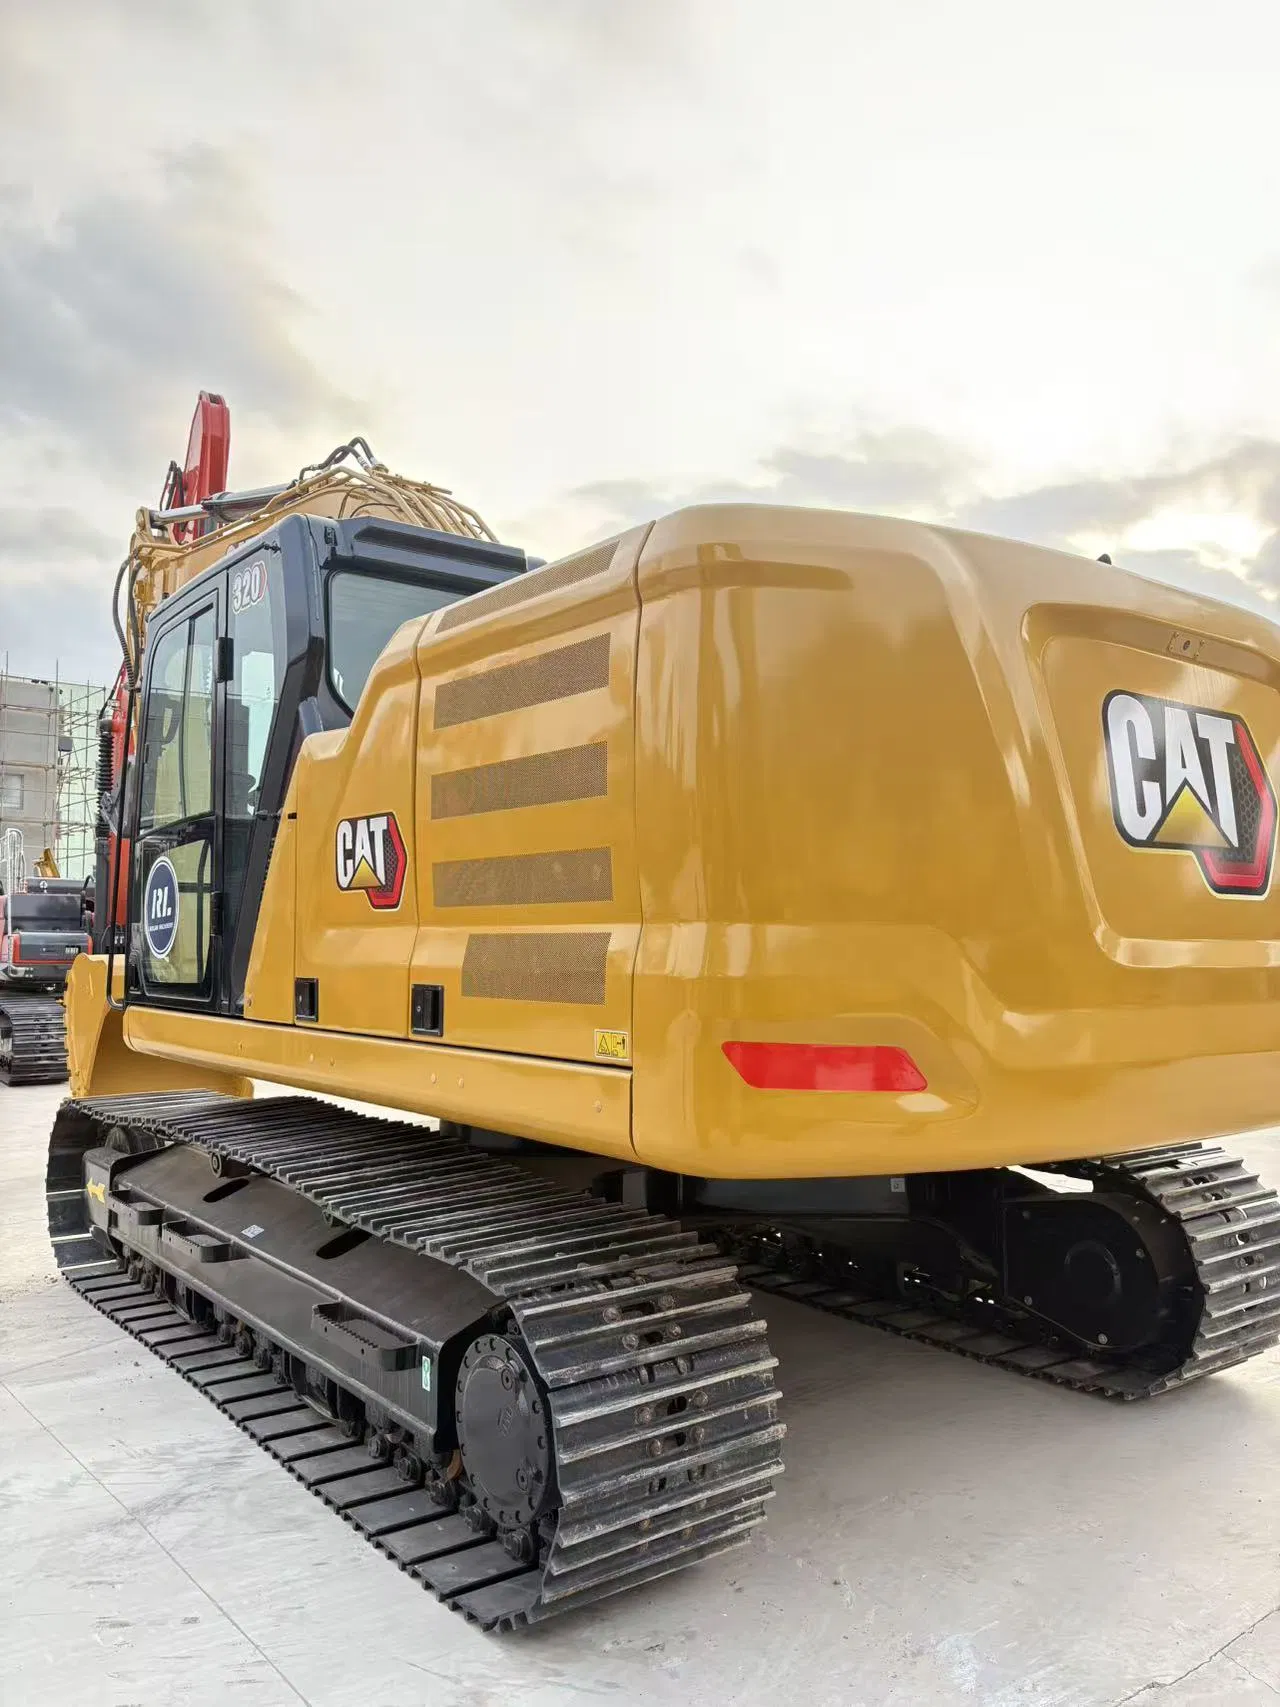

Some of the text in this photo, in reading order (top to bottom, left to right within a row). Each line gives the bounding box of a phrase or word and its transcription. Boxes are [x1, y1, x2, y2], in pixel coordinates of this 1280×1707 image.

[233, 563, 262, 613] 320
[1108, 695, 1239, 848] CAT
[336, 816, 387, 888] CAT
